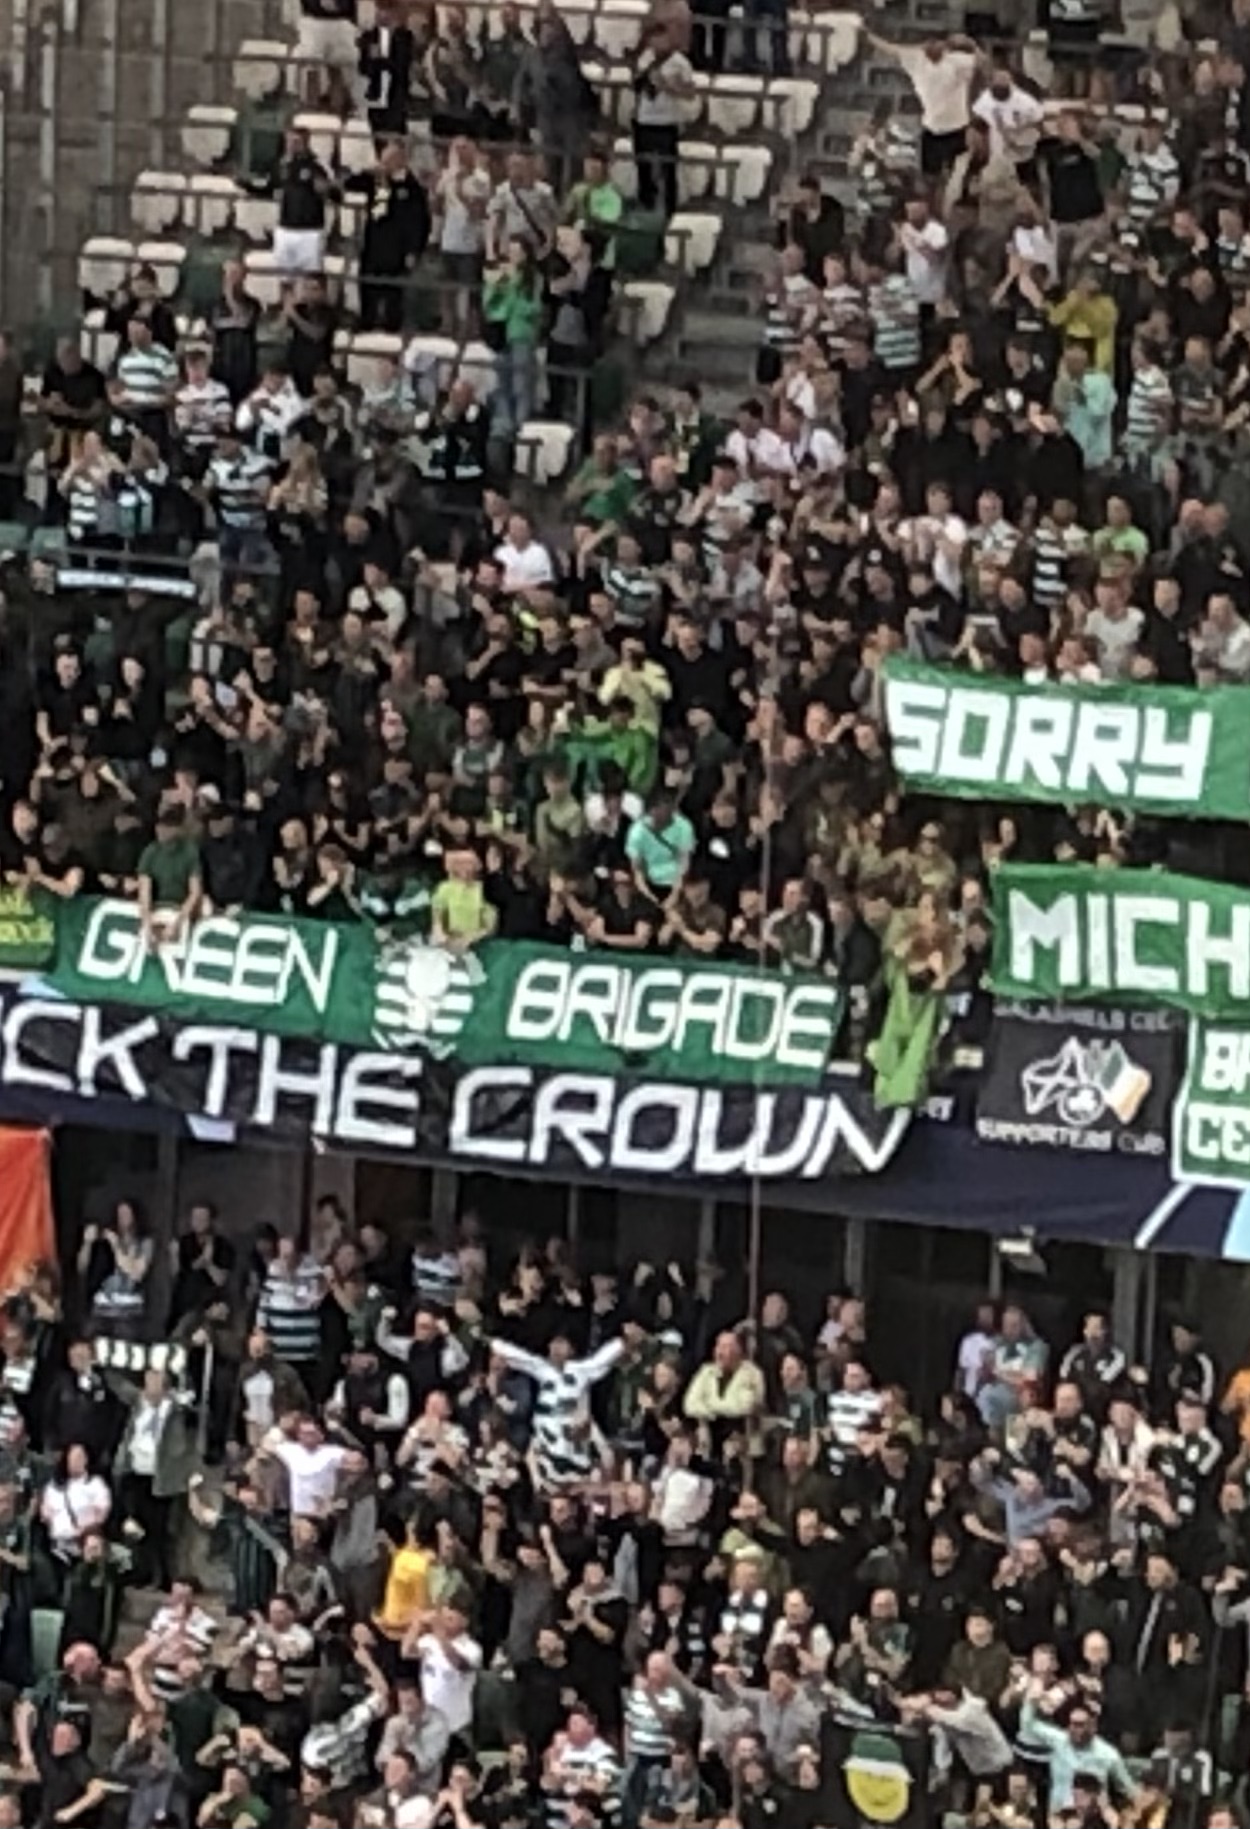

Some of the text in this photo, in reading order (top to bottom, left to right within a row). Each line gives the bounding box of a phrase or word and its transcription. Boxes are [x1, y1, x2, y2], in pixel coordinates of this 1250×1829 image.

[886, 678, 1212, 800] SORRY
[77, 898, 836, 1066] GREEN BRIGADE
[173, 1026, 426, 1148] THE
[449, 1066, 912, 1178] CROWN
